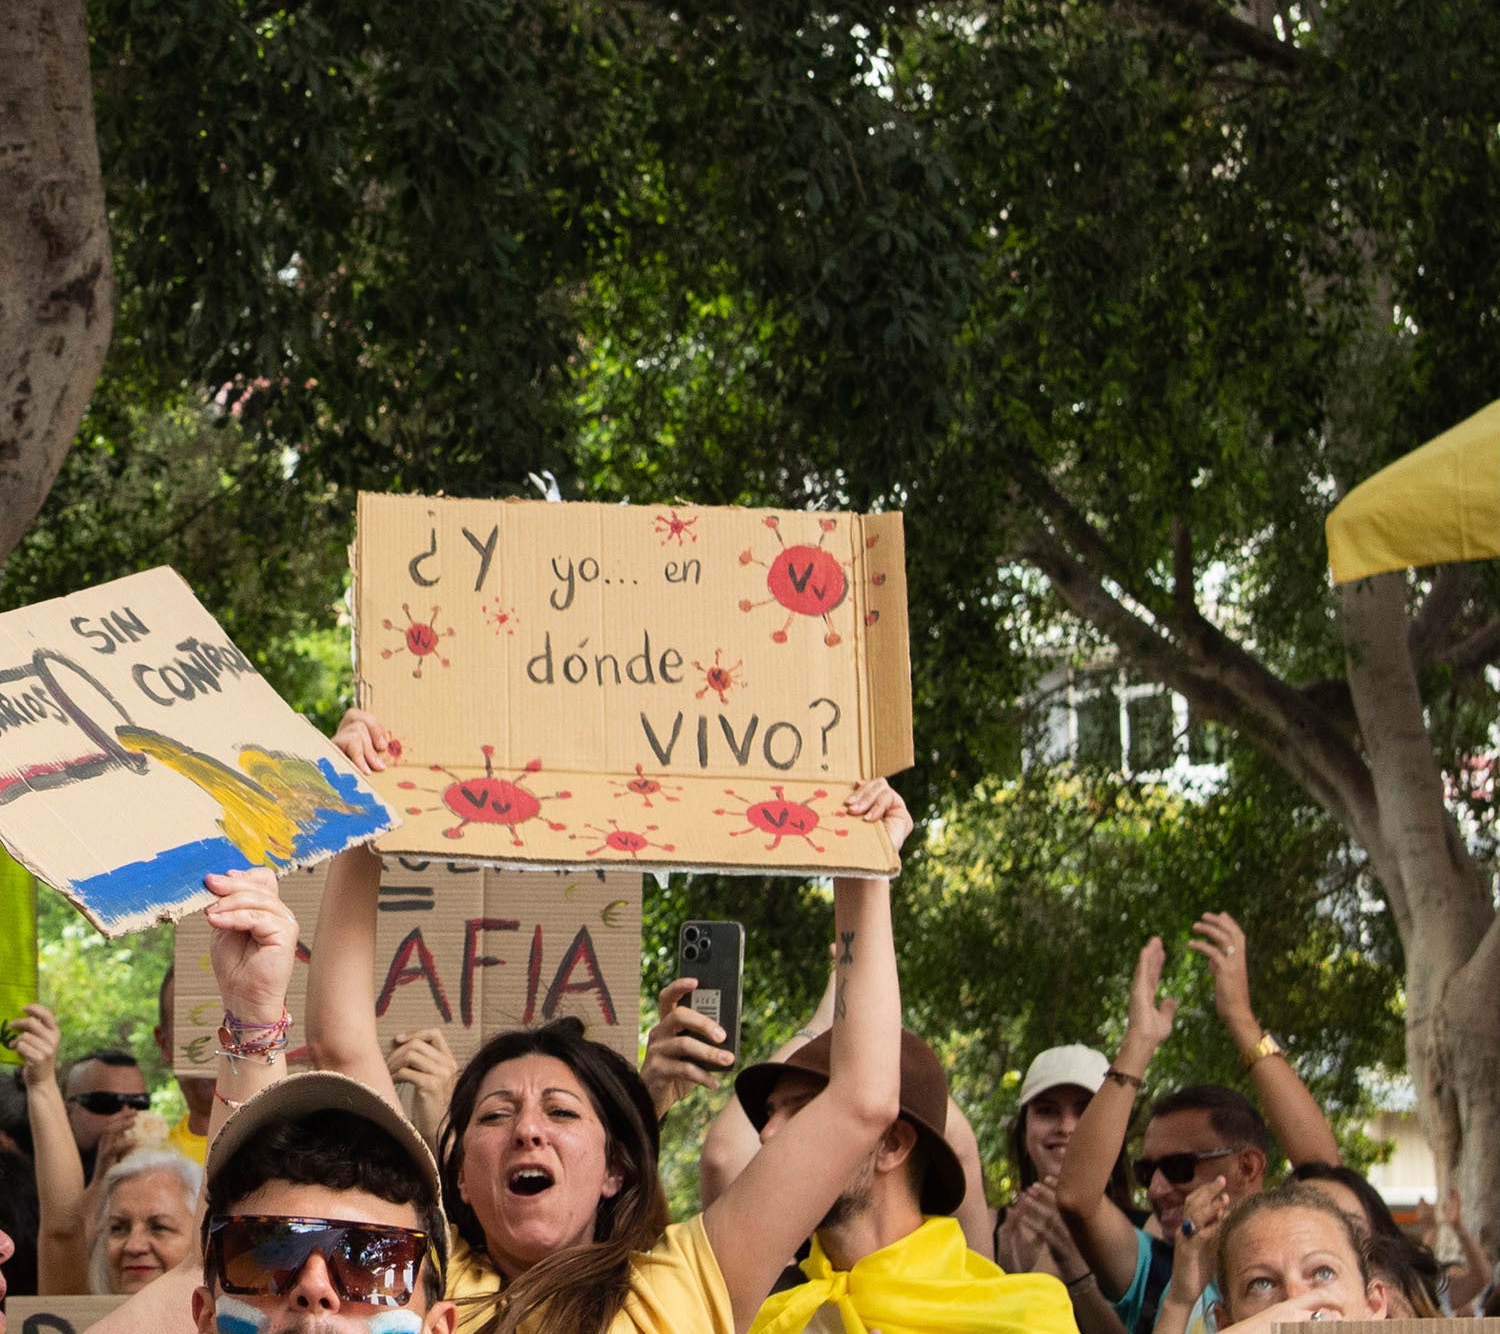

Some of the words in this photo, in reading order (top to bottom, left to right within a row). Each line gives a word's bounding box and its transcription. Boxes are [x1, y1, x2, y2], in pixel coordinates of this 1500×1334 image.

[663, 554, 702, 584] en
[69, 606, 151, 655] SIN
[526, 629, 685, 686] dónde
[639, 697, 842, 771] VIVO?
[296, 918, 619, 1028] AFIA
